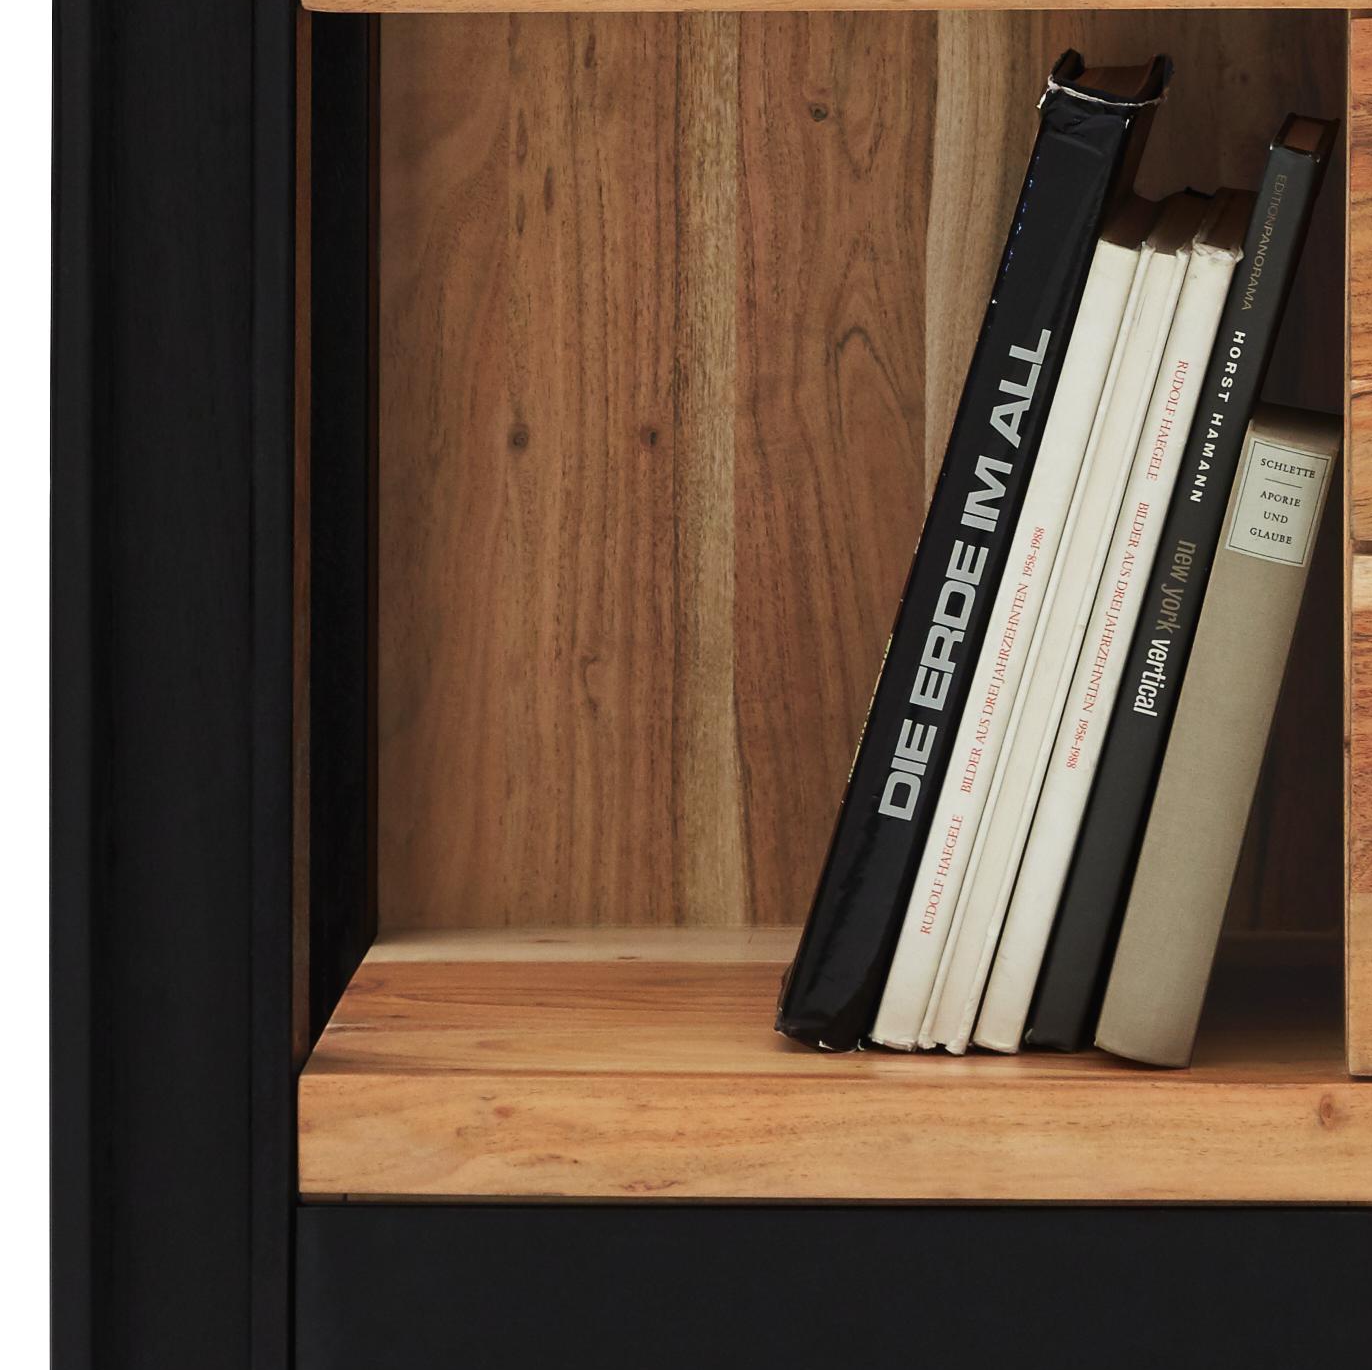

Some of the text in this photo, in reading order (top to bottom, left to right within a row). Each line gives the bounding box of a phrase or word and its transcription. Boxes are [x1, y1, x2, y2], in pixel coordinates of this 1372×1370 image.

[1241, 173, 1287, 311] EDITIONPANORAMA
[1164, 360, 1189, 416] RUDOLF
[1190, 330, 1246, 503] HORST HAMANN
[1145, 417, 1173, 482] HAEGELE
[1260, 458, 1316, 479] SCHLETTE
[1260, 490, 1301, 507] APORIE
[1263, 510, 1289, 524] UND
[1127, 502, 1150, 548] BILDER
[1249, 527, 1292, 545] GLAUBE
[878, 328, 1052, 821] DIE ERDE IM ALL
[1120, 555, 1135, 577] AUS
[1110, 580, 1128, 612] DREI
[992, 583, 1029, 684] JAHRZEHNTEN
[1133, 539, 1196, 717] new york vertical
[1082, 611, 1119, 711] JAHRZEHNTEN
[982, 683, 1000, 716] DREI
[975, 719, 990, 740] AUS
[960, 748, 983, 793] BILDER
[937, 813, 963, 876] HAEGELE
[920, 877, 945, 935] RUDOLF
